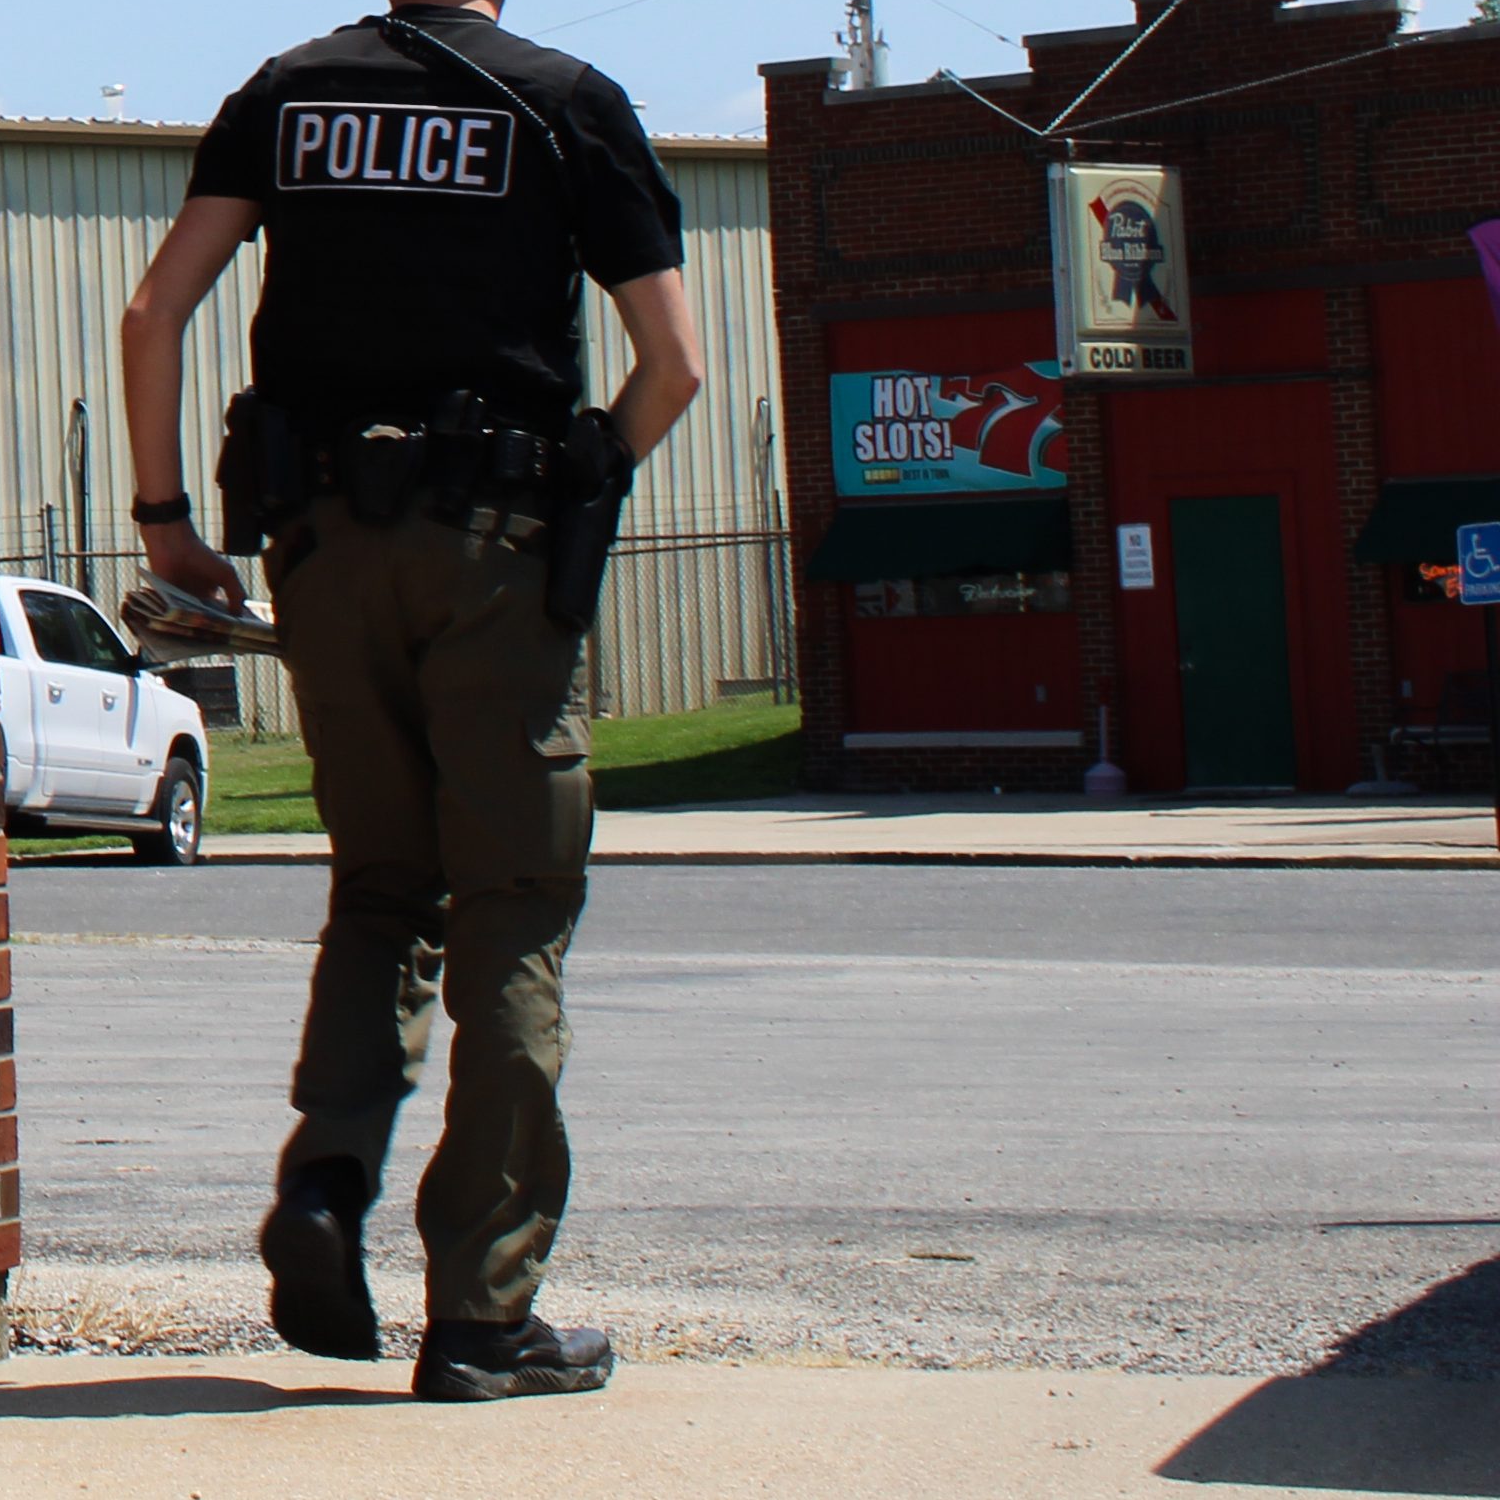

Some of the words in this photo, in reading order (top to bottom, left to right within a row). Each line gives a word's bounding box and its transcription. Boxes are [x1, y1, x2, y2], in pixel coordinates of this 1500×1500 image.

[292, 112, 494, 186] POLICE
[1108, 211, 1147, 239] Pabst
[1089, 346, 1134, 370] COLD
[1142, 347, 1186, 370] BEER
[872, 375, 932, 419] HOT
[854, 420, 954, 462] SLOTS!
